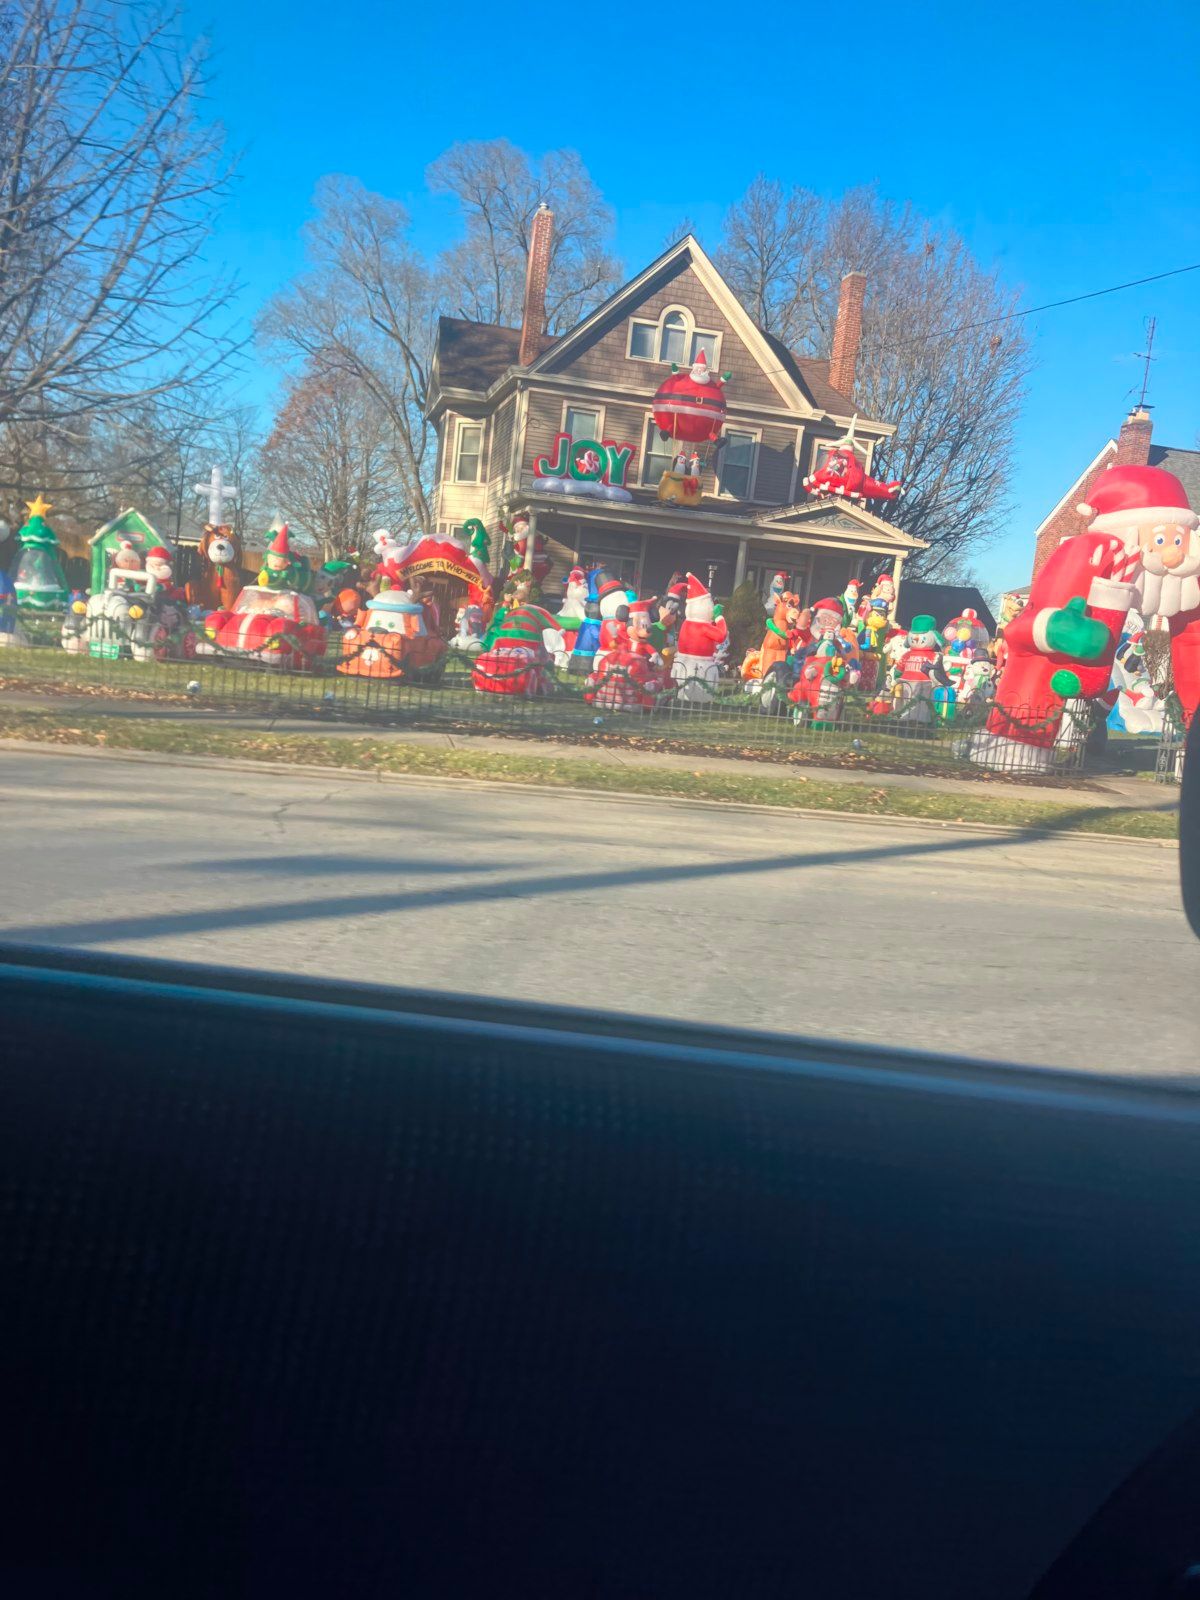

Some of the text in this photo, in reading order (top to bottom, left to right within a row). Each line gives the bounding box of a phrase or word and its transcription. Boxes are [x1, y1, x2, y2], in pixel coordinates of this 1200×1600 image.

[535, 434, 635, 487] JOY
[400, 561, 434, 577] WELCOME
[436, 559, 444, 567] TO
